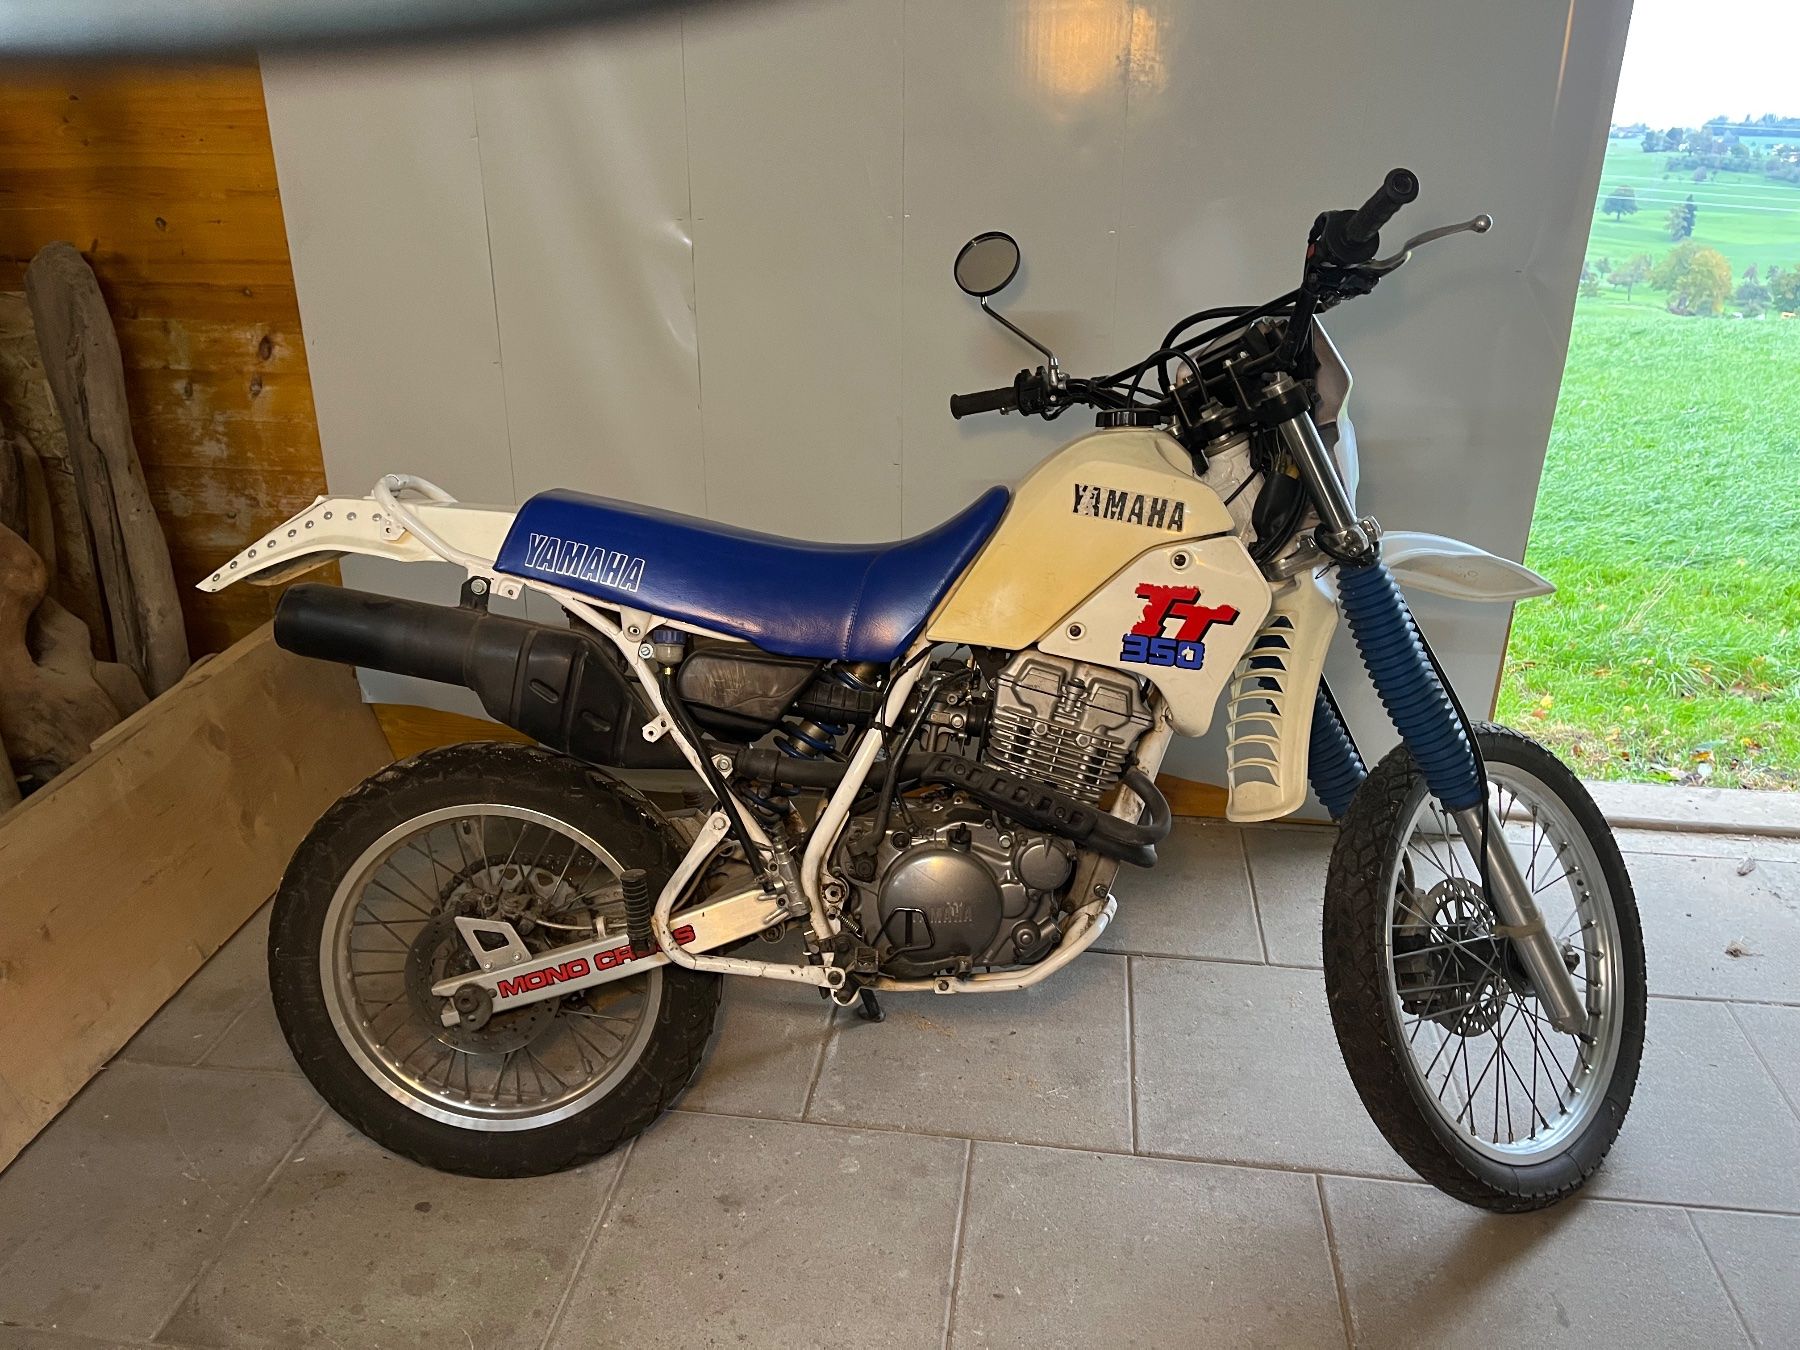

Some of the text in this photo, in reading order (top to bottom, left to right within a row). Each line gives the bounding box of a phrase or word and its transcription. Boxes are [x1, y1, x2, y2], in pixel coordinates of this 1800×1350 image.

[1073, 483, 1185, 532] YAMAHA
[525, 533, 645, 592] YAMAHA
[1119, 634, 1205, 670] 350
[497, 925, 696, 998] MONO CRS
